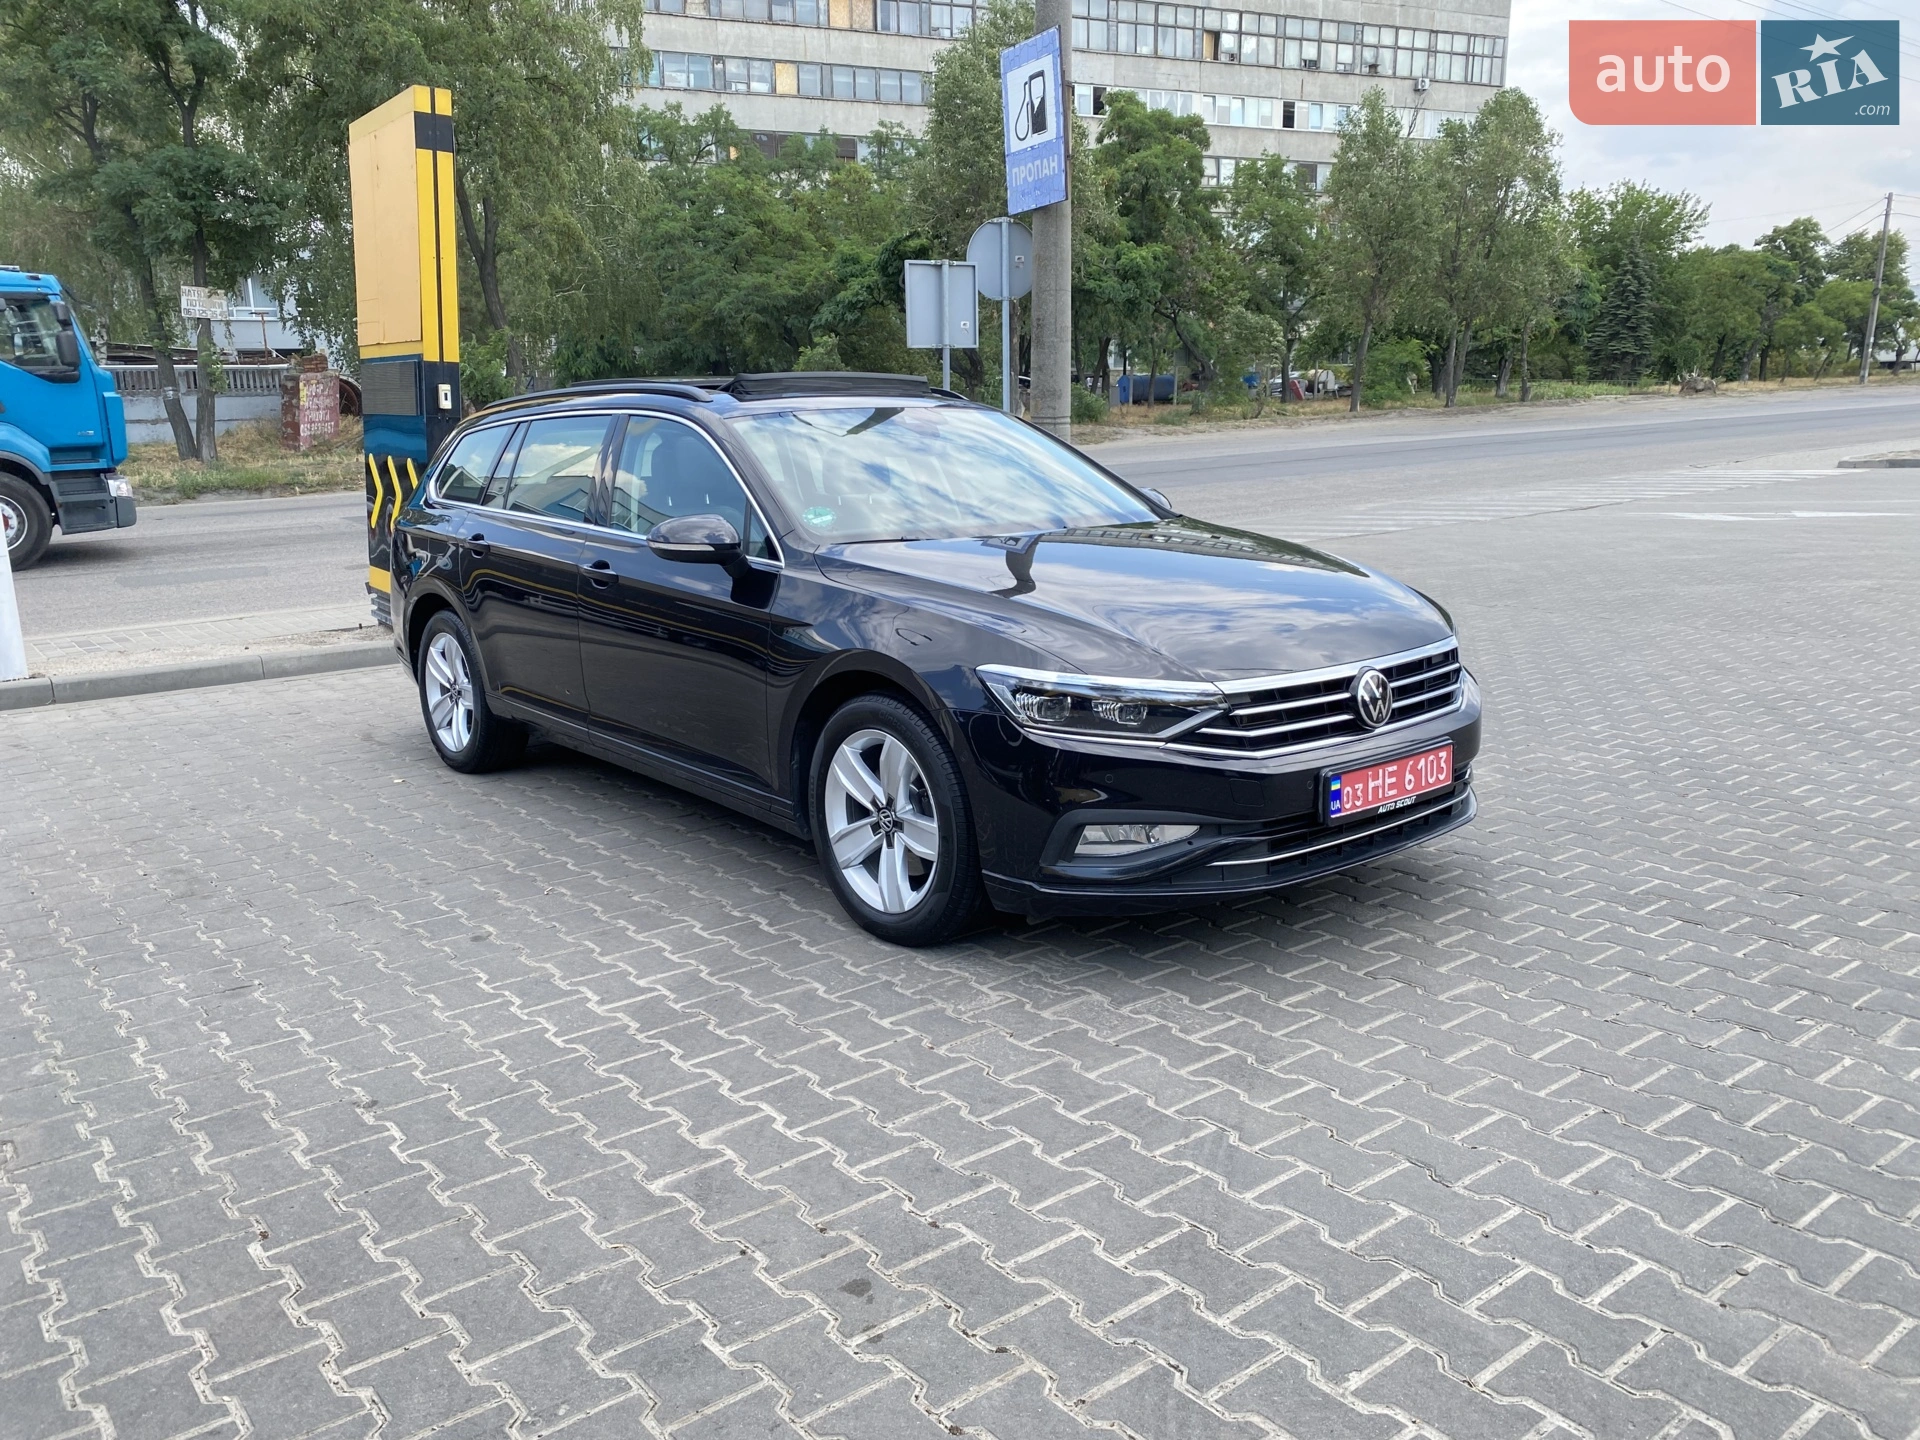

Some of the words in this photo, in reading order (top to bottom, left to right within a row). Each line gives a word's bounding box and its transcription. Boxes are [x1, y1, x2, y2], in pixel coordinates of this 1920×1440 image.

[1011, 153, 1058, 188] ПРОПАН
[1330, 800, 1341, 811] UA
[1343, 783, 1364, 810] 03
[1367, 764, 1398, 802] HE
[1404, 751, 1447, 791] 6103
[1378, 802, 1396, 814] AUTO
[1395, 795, 1417, 809] SCOUT
